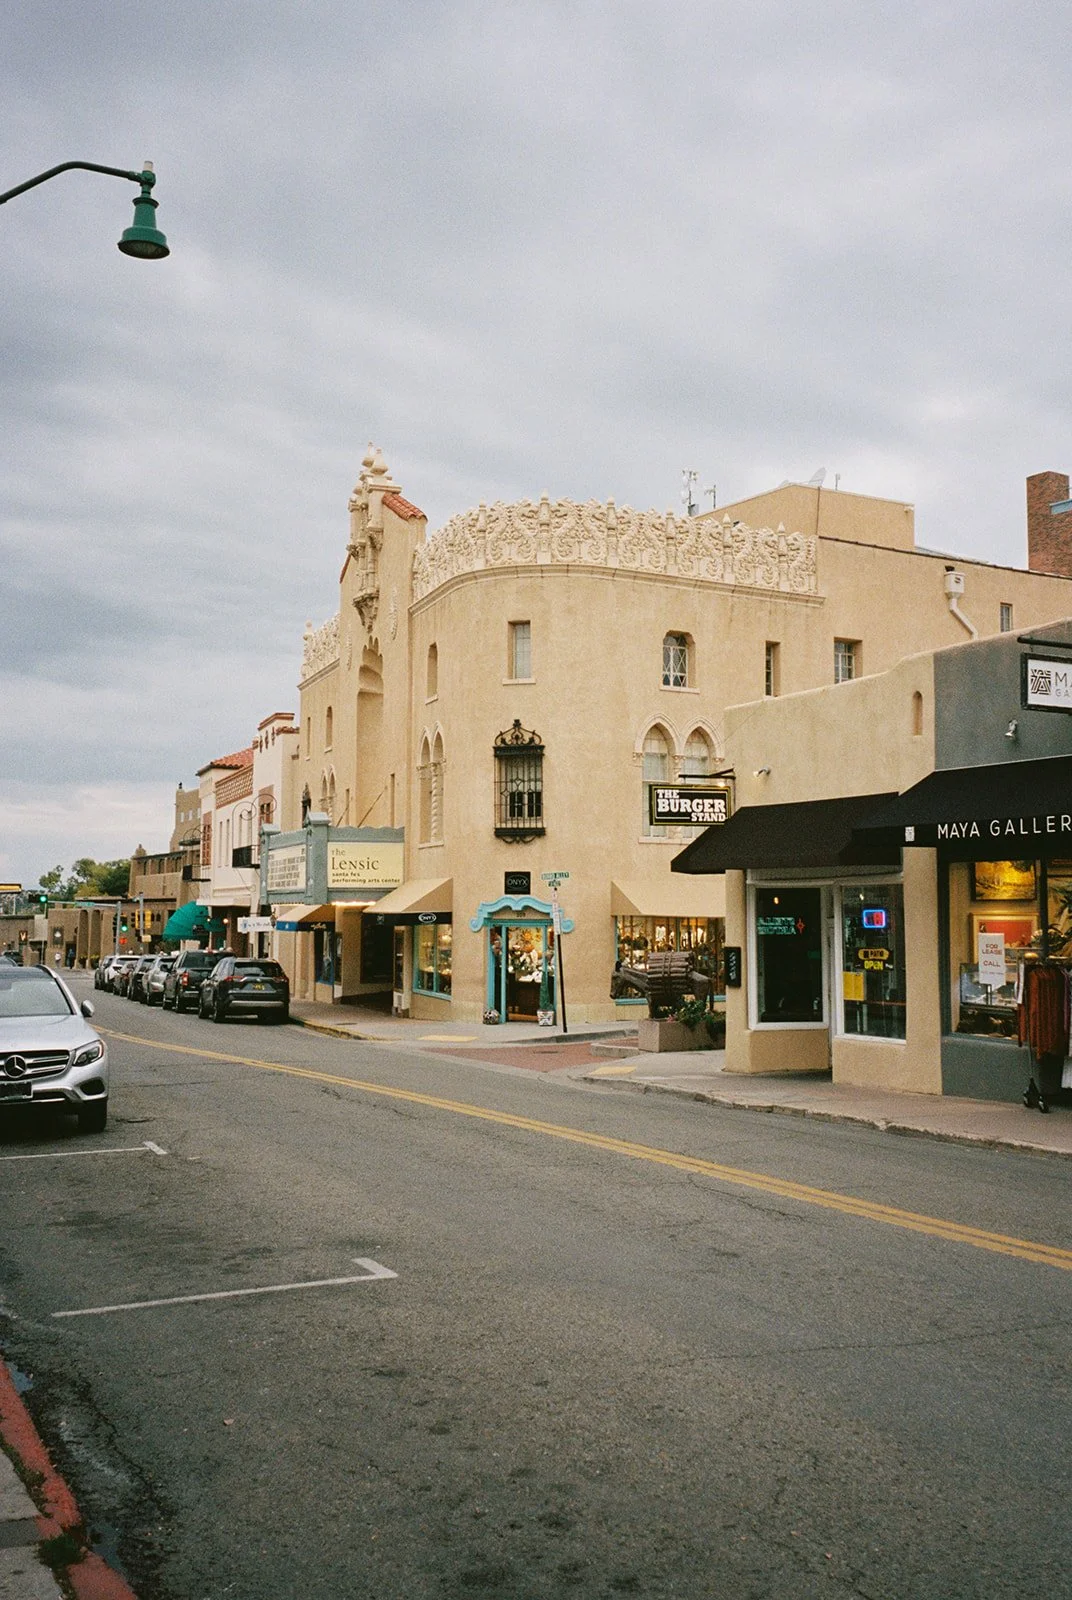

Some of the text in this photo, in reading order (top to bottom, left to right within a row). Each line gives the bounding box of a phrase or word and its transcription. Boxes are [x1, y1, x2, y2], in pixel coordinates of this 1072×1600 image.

[657, 789, 679, 798] THE
[657, 799, 726, 813] BURGER
[691, 813, 726, 822] STAND
[937, 815, 1072, 840] MAYA GALLER
[331, 848, 346, 856] the
[508, 878, 528, 886] ONYX
[864, 960, 884, 970] OPEN
